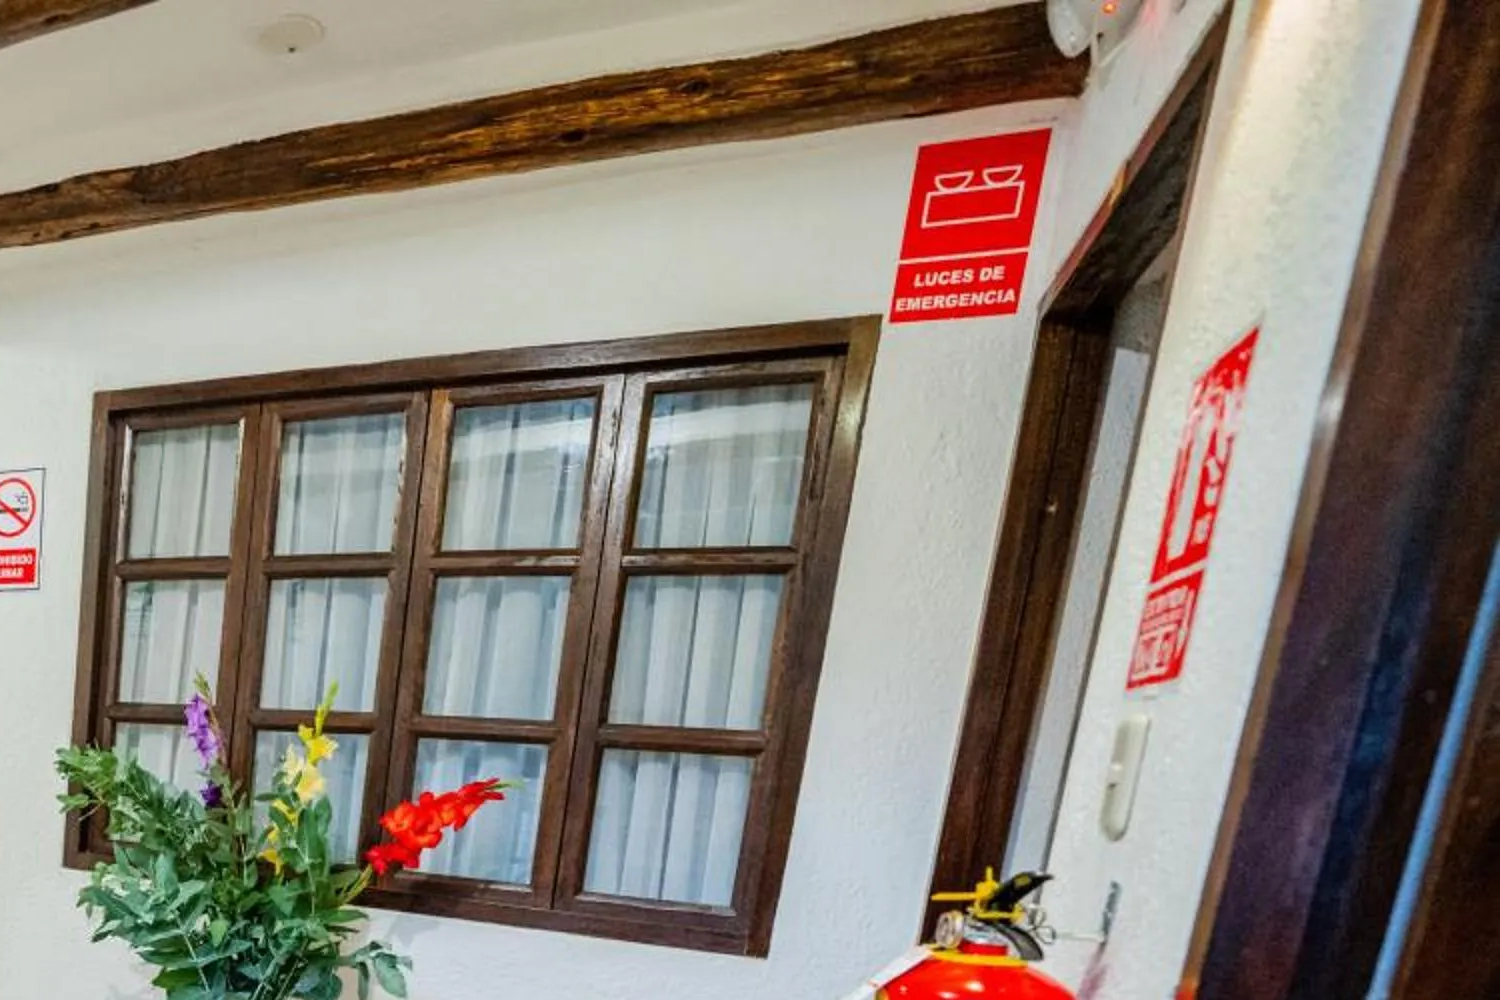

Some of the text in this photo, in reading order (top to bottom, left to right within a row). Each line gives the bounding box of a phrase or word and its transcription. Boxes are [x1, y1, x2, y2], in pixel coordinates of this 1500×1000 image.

[914, 265, 1005, 288] LUCES DE
[895, 288, 1016, 312] EMERGENCIA
